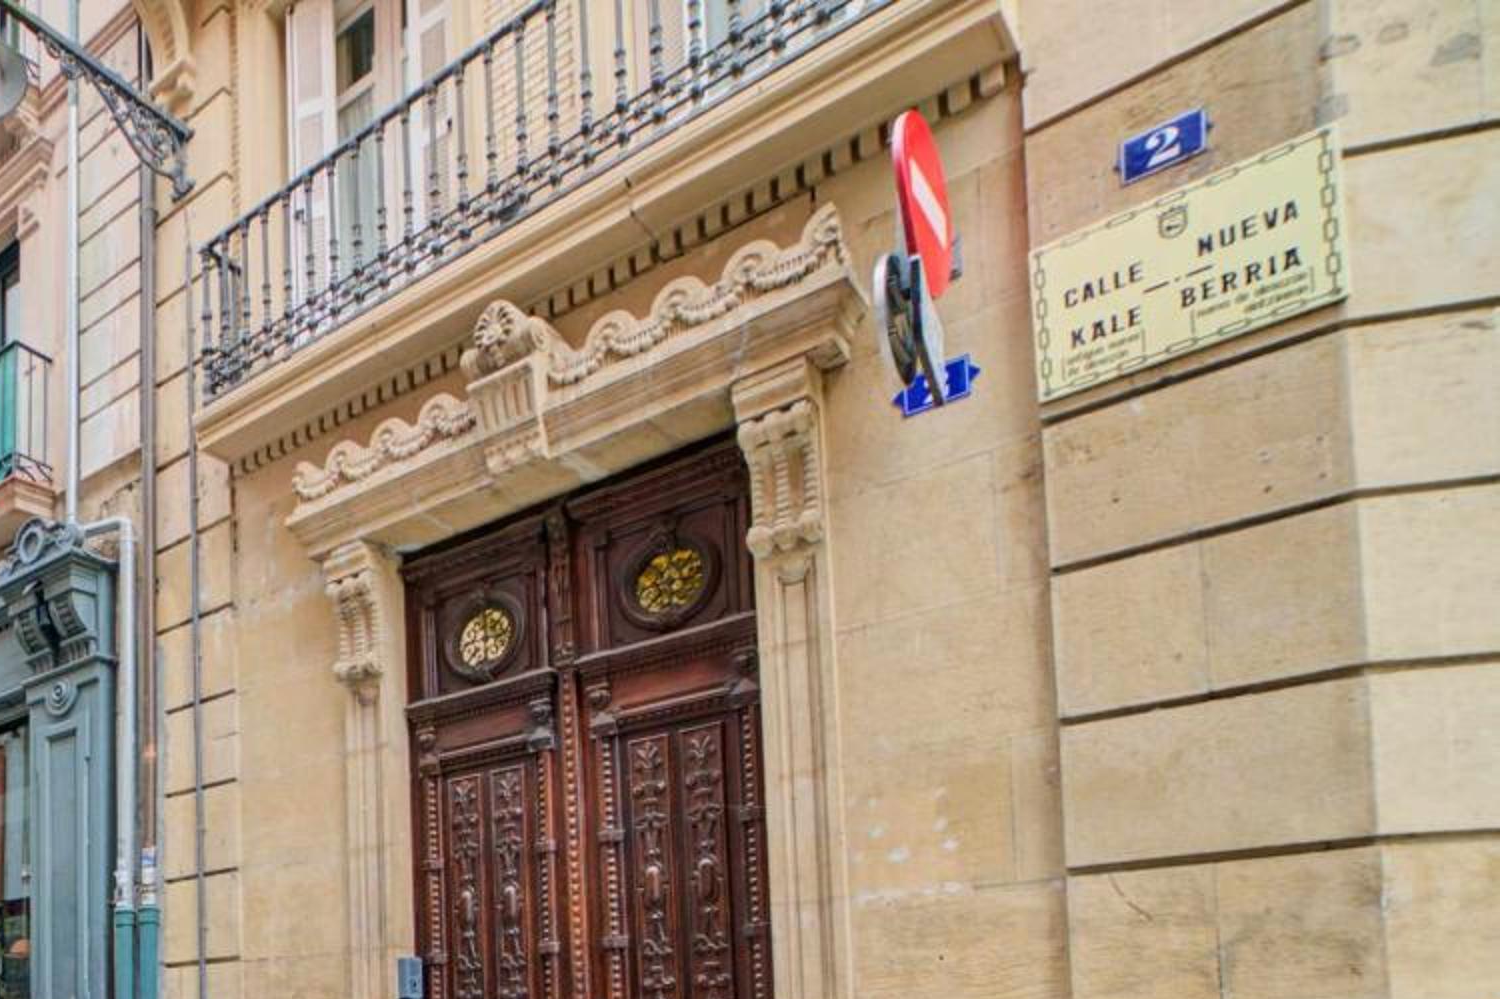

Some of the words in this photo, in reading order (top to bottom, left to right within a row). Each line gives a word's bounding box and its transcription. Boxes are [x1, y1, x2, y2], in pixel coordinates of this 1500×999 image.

[1145, 127, 1181, 168] 2
[1063, 260, 1144, 309] CALLE
[1197, 200, 1299, 257] NUEVA
[1070, 305, 1142, 349] KALE
[1180, 246, 1302, 309] BERRIA
